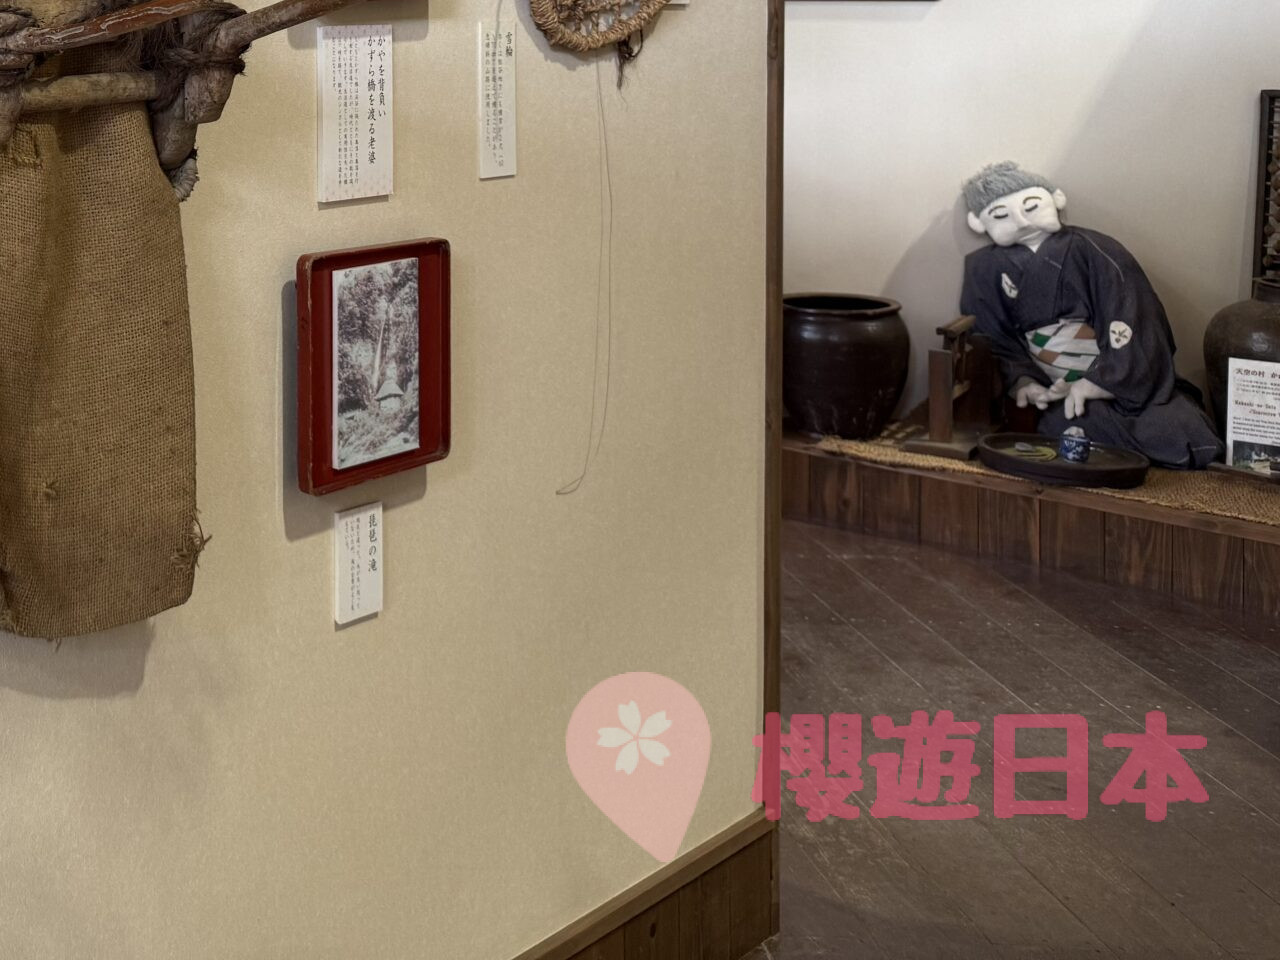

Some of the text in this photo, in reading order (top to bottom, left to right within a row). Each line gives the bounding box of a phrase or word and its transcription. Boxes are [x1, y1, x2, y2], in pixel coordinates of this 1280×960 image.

[367, 35, 377, 165] かずら橋を渡る老婆
[377, 35, 387, 117] かやを背負い
